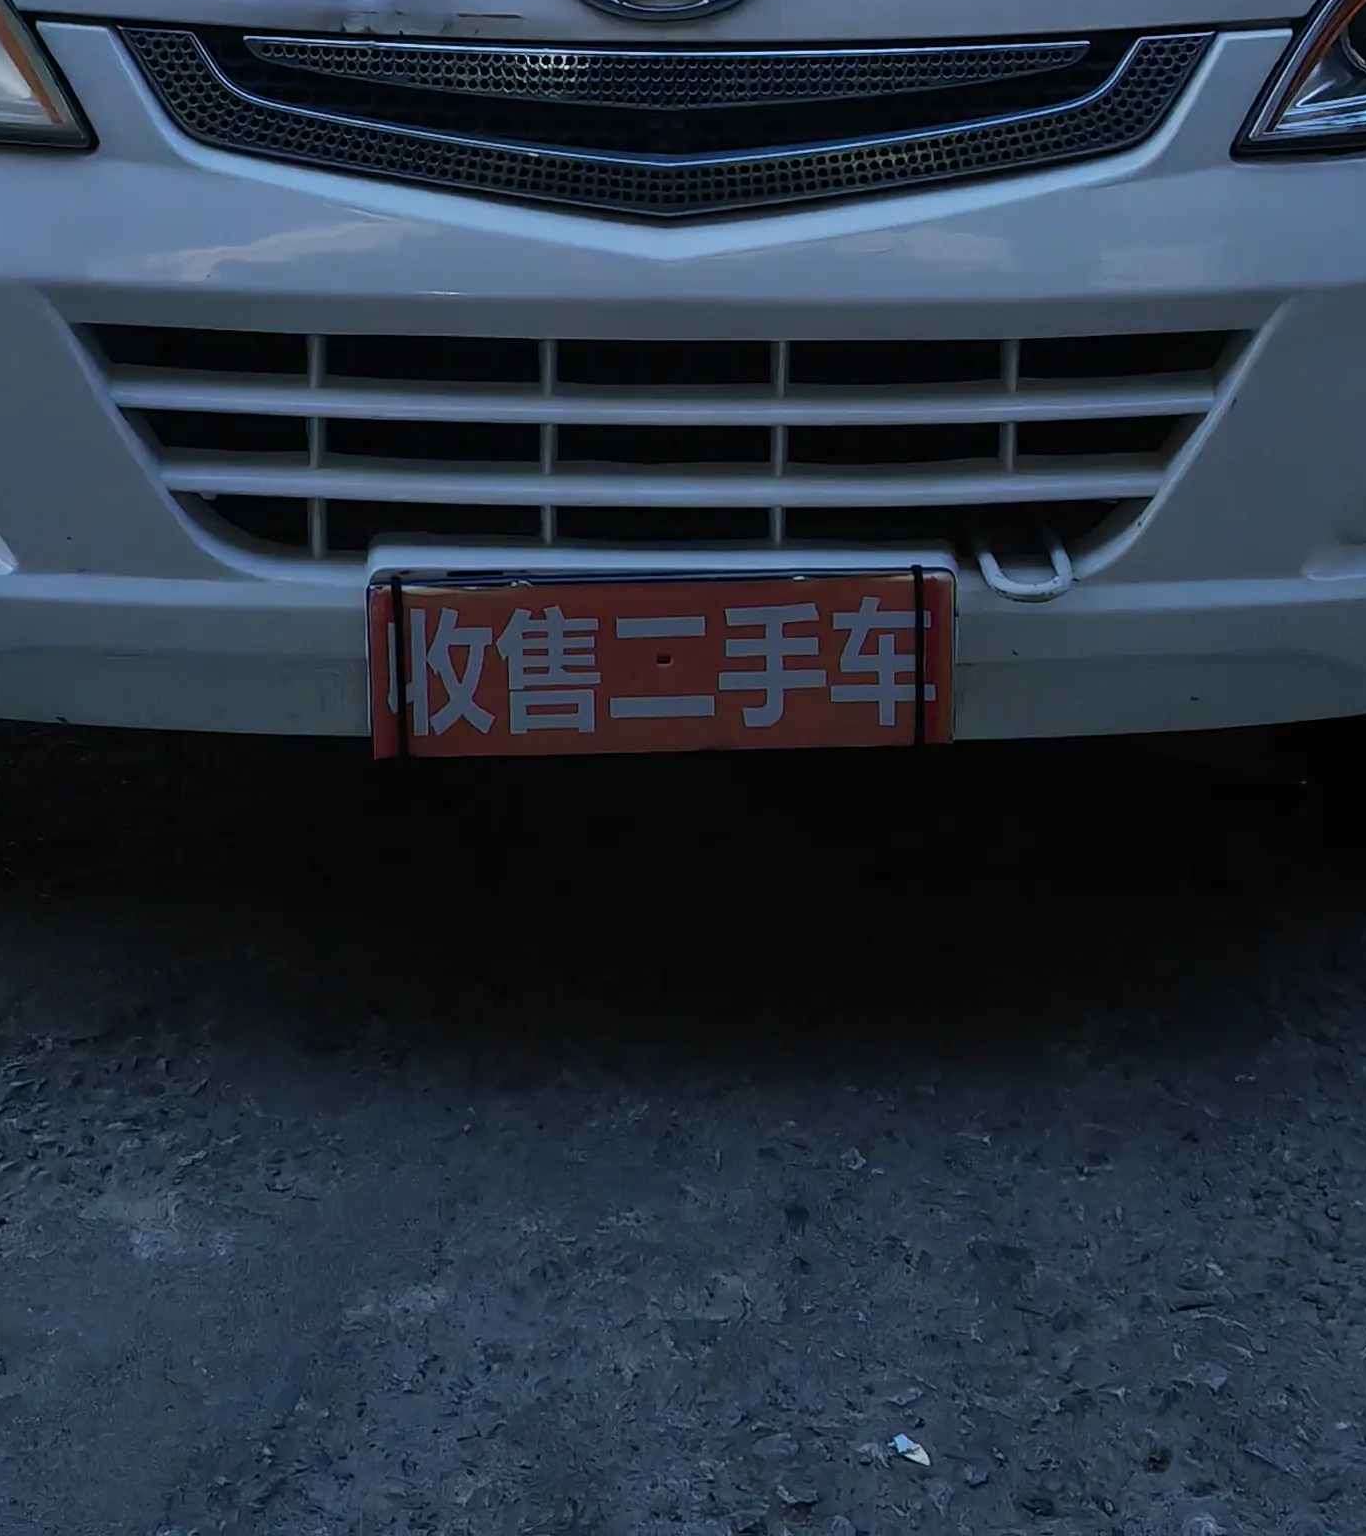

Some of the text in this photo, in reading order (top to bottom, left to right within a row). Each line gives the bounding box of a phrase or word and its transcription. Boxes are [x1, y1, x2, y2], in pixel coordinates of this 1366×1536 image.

[387, 595, 936, 737] 收售二手车
